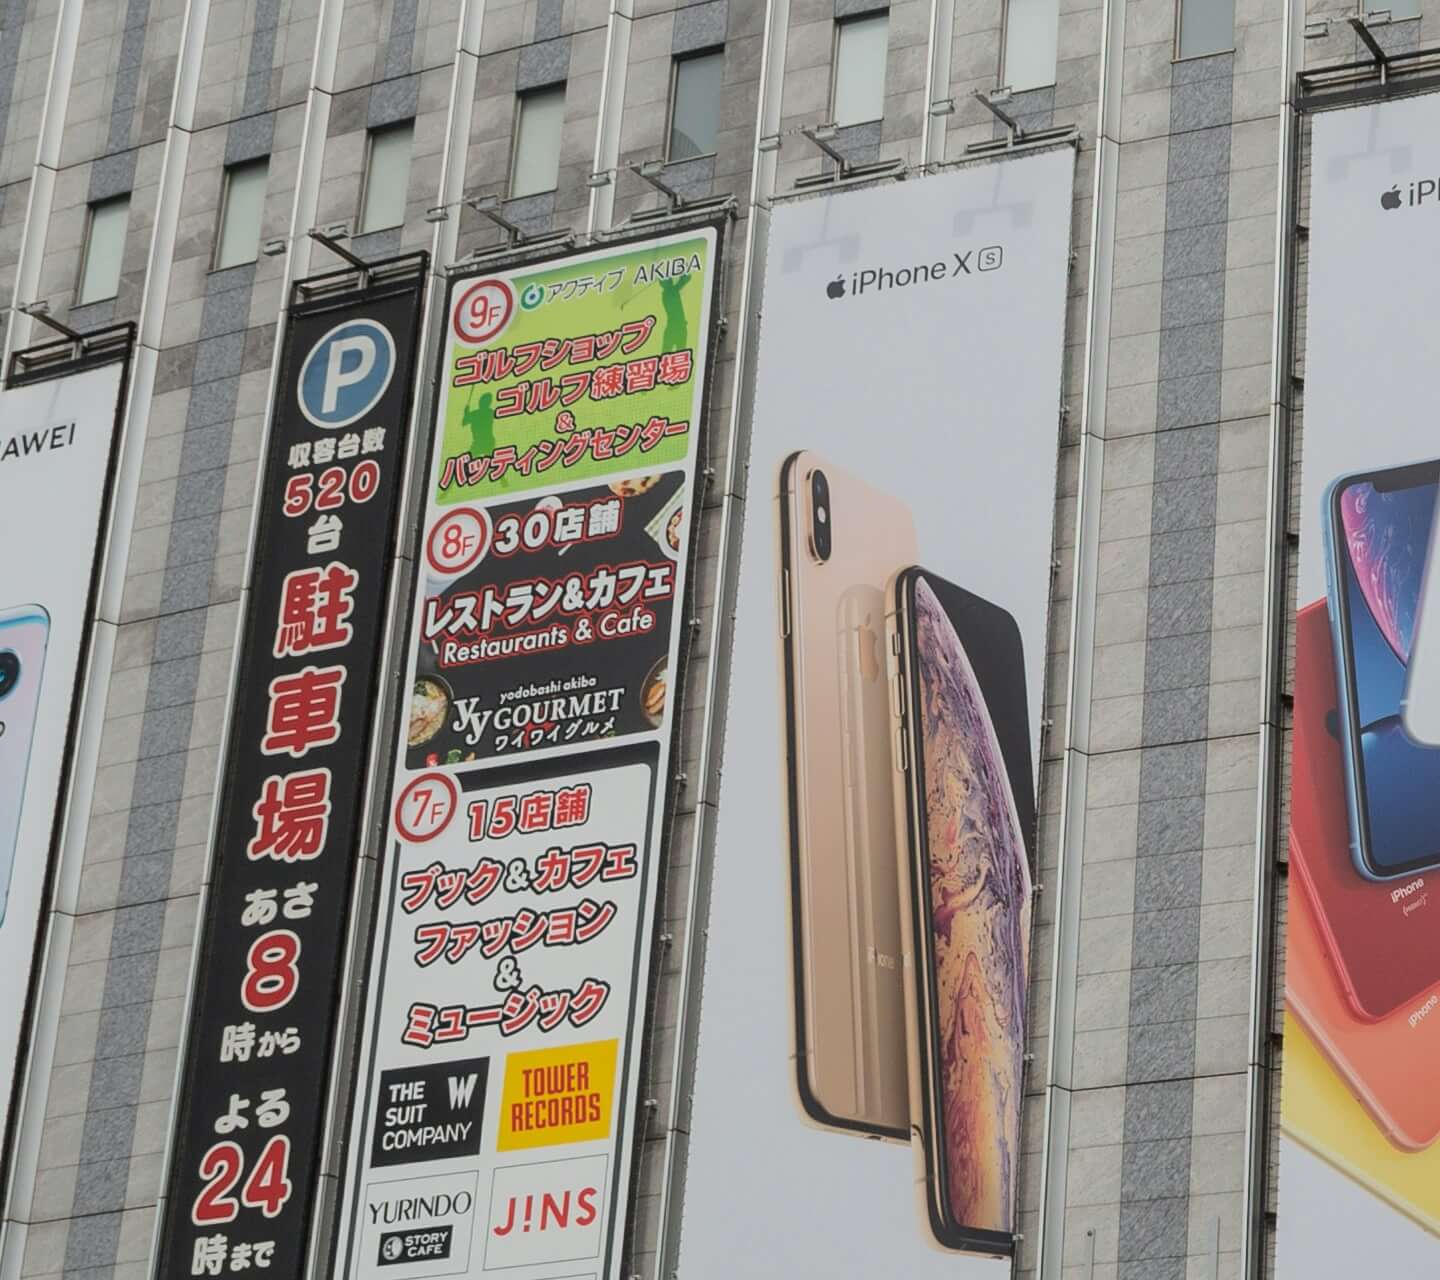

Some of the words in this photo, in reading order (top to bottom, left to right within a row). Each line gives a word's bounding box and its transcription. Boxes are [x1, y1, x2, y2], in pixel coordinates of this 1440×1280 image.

[546, 268, 625, 303] アクティブ
[633, 254, 701, 284] AKIBA
[850, 261, 947, 296] iPhone
[453, 314, 657, 387] ゴルフショップ
[495, 349, 693, 418] ゴルフ練習場
[286, 426, 386, 470] 収容台数
[438, 416, 690, 489] バッティングセンター
[282, 458, 380, 517] 520
[307, 513, 344, 555] 台
[492, 499, 622, 554] 30店舗
[443, 625, 568, 664] Restaurants
[600, 607, 654, 637] Cafe
[492, 686, 625, 729] GOURMET
[500, 680, 561, 704] yodobashi
[563, 674, 597, 691] akiba
[246, 560, 359, 864] 駐車場
[467, 782, 592, 842] 15店舗
[240, 880, 319, 927] あさ
[1391, 877, 1425, 904] iPhone
[414, 898, 618, 967] ファッション
[240, 928, 302, 1013] 8
[400, 977, 611, 1049] ミュージック
[219, 1021, 302, 1063] 時から
[388, 1080, 426, 1102] THE
[521, 1061, 590, 1099] TOWER
[214, 1087, 291, 1135] よる
[384, 1103, 428, 1128] SUIT
[511, 1093, 601, 1133] RECORDS
[381, 1121, 473, 1152] COMPANY
[191, 1133, 292, 1227] 24
[368, 1190, 472, 1226] YURINDO
[190, 1234, 276, 1277] 時まで
[404, 1231, 449, 1247] STORY
[407, 1242, 444, 1258] CAFE
